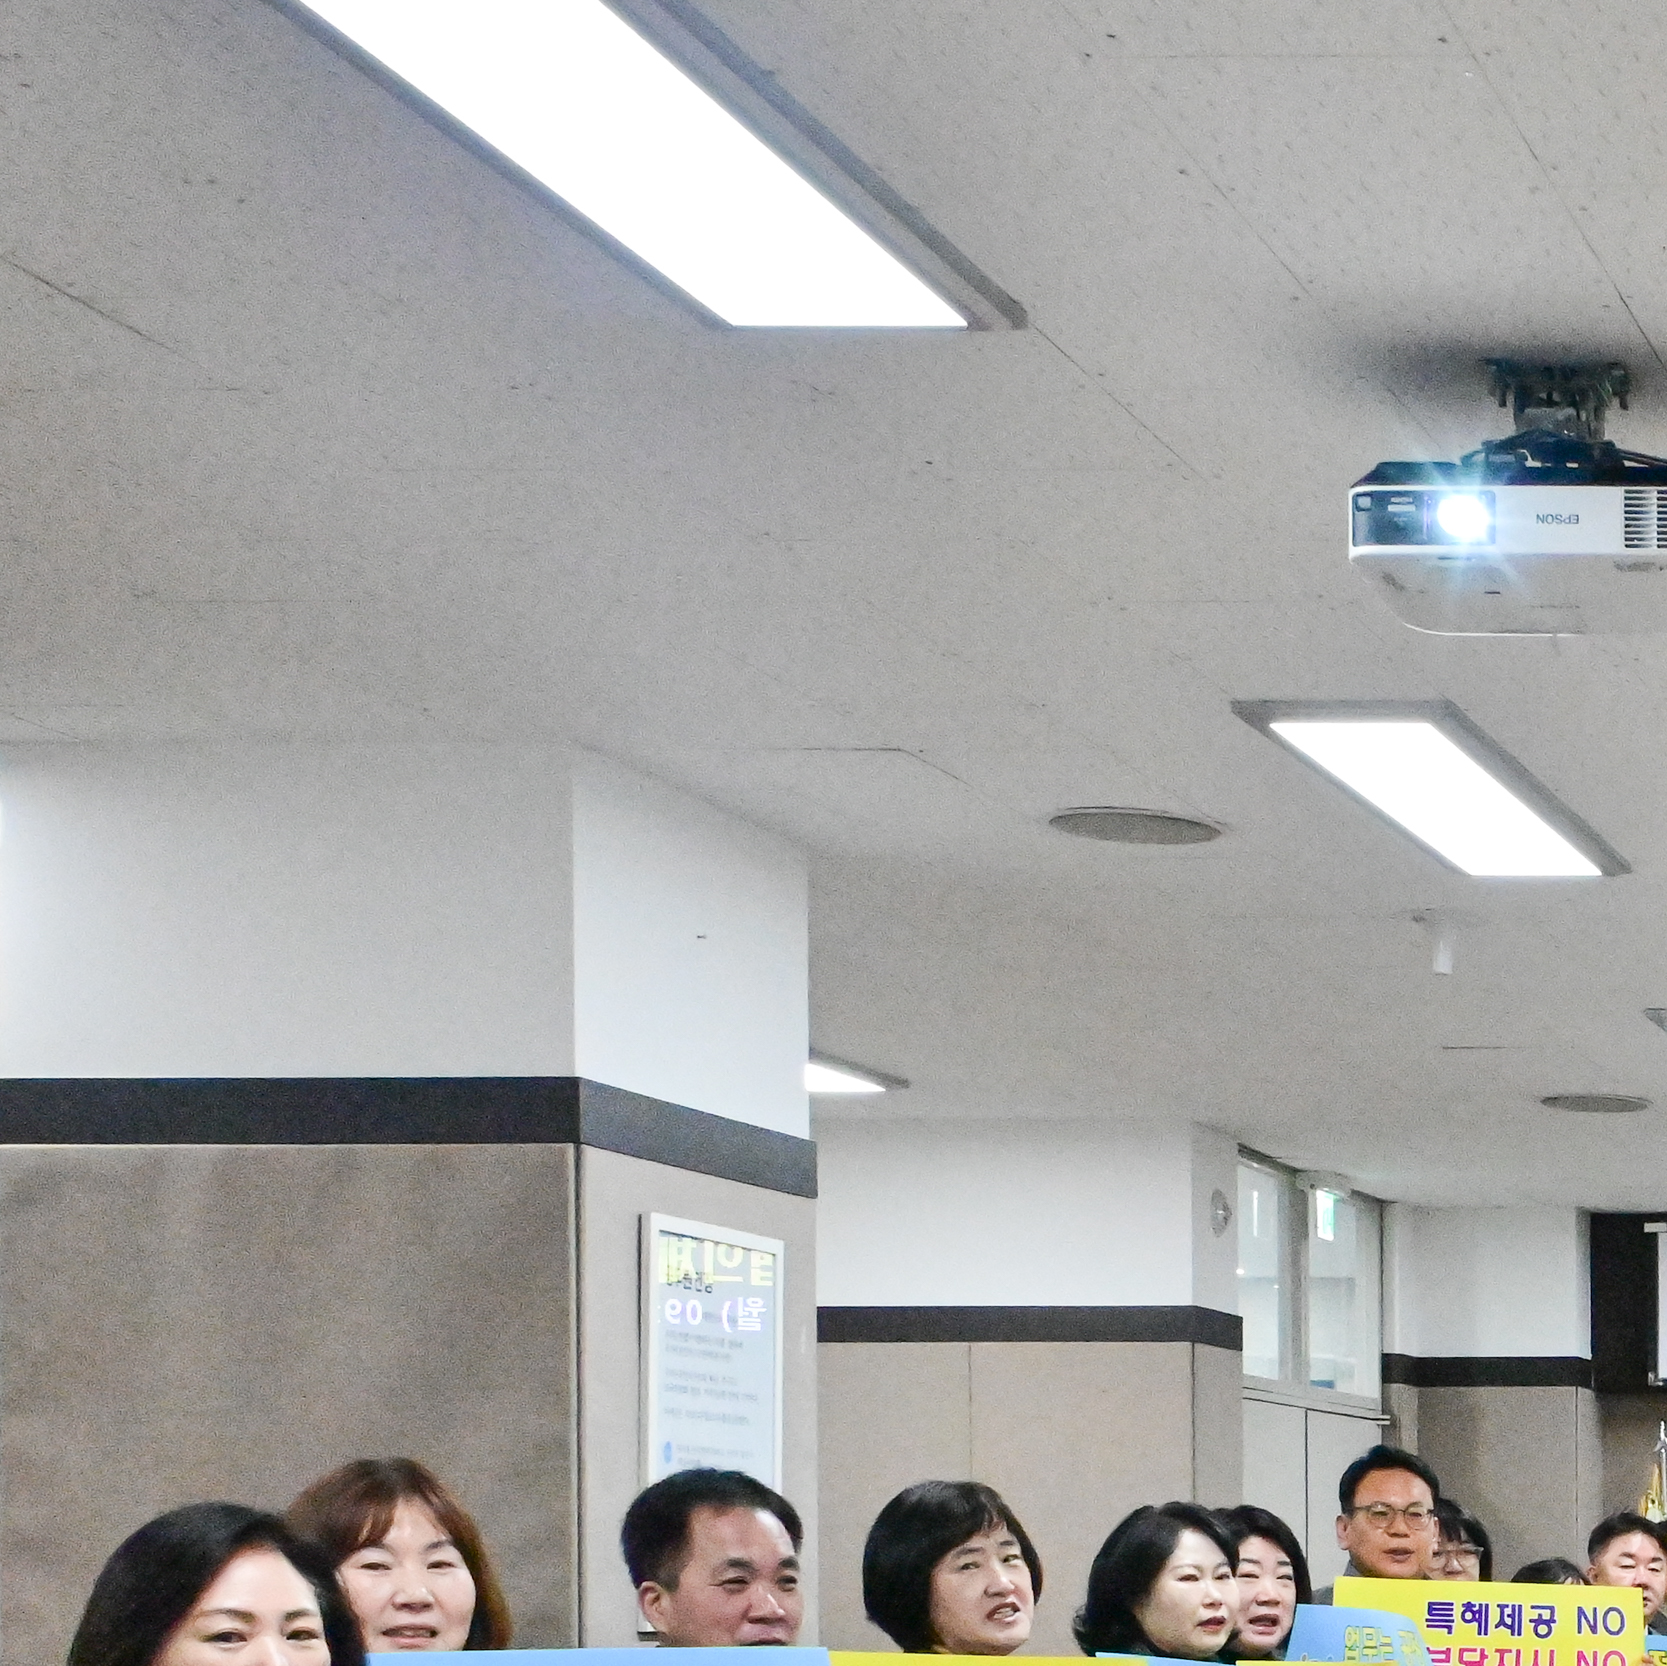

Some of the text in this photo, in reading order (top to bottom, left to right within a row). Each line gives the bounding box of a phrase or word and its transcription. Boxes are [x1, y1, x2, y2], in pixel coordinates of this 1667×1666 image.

[1536, 513, 1579, 525] EPSON
[1425, 1602, 1626, 1639] 특혜제공 NO
